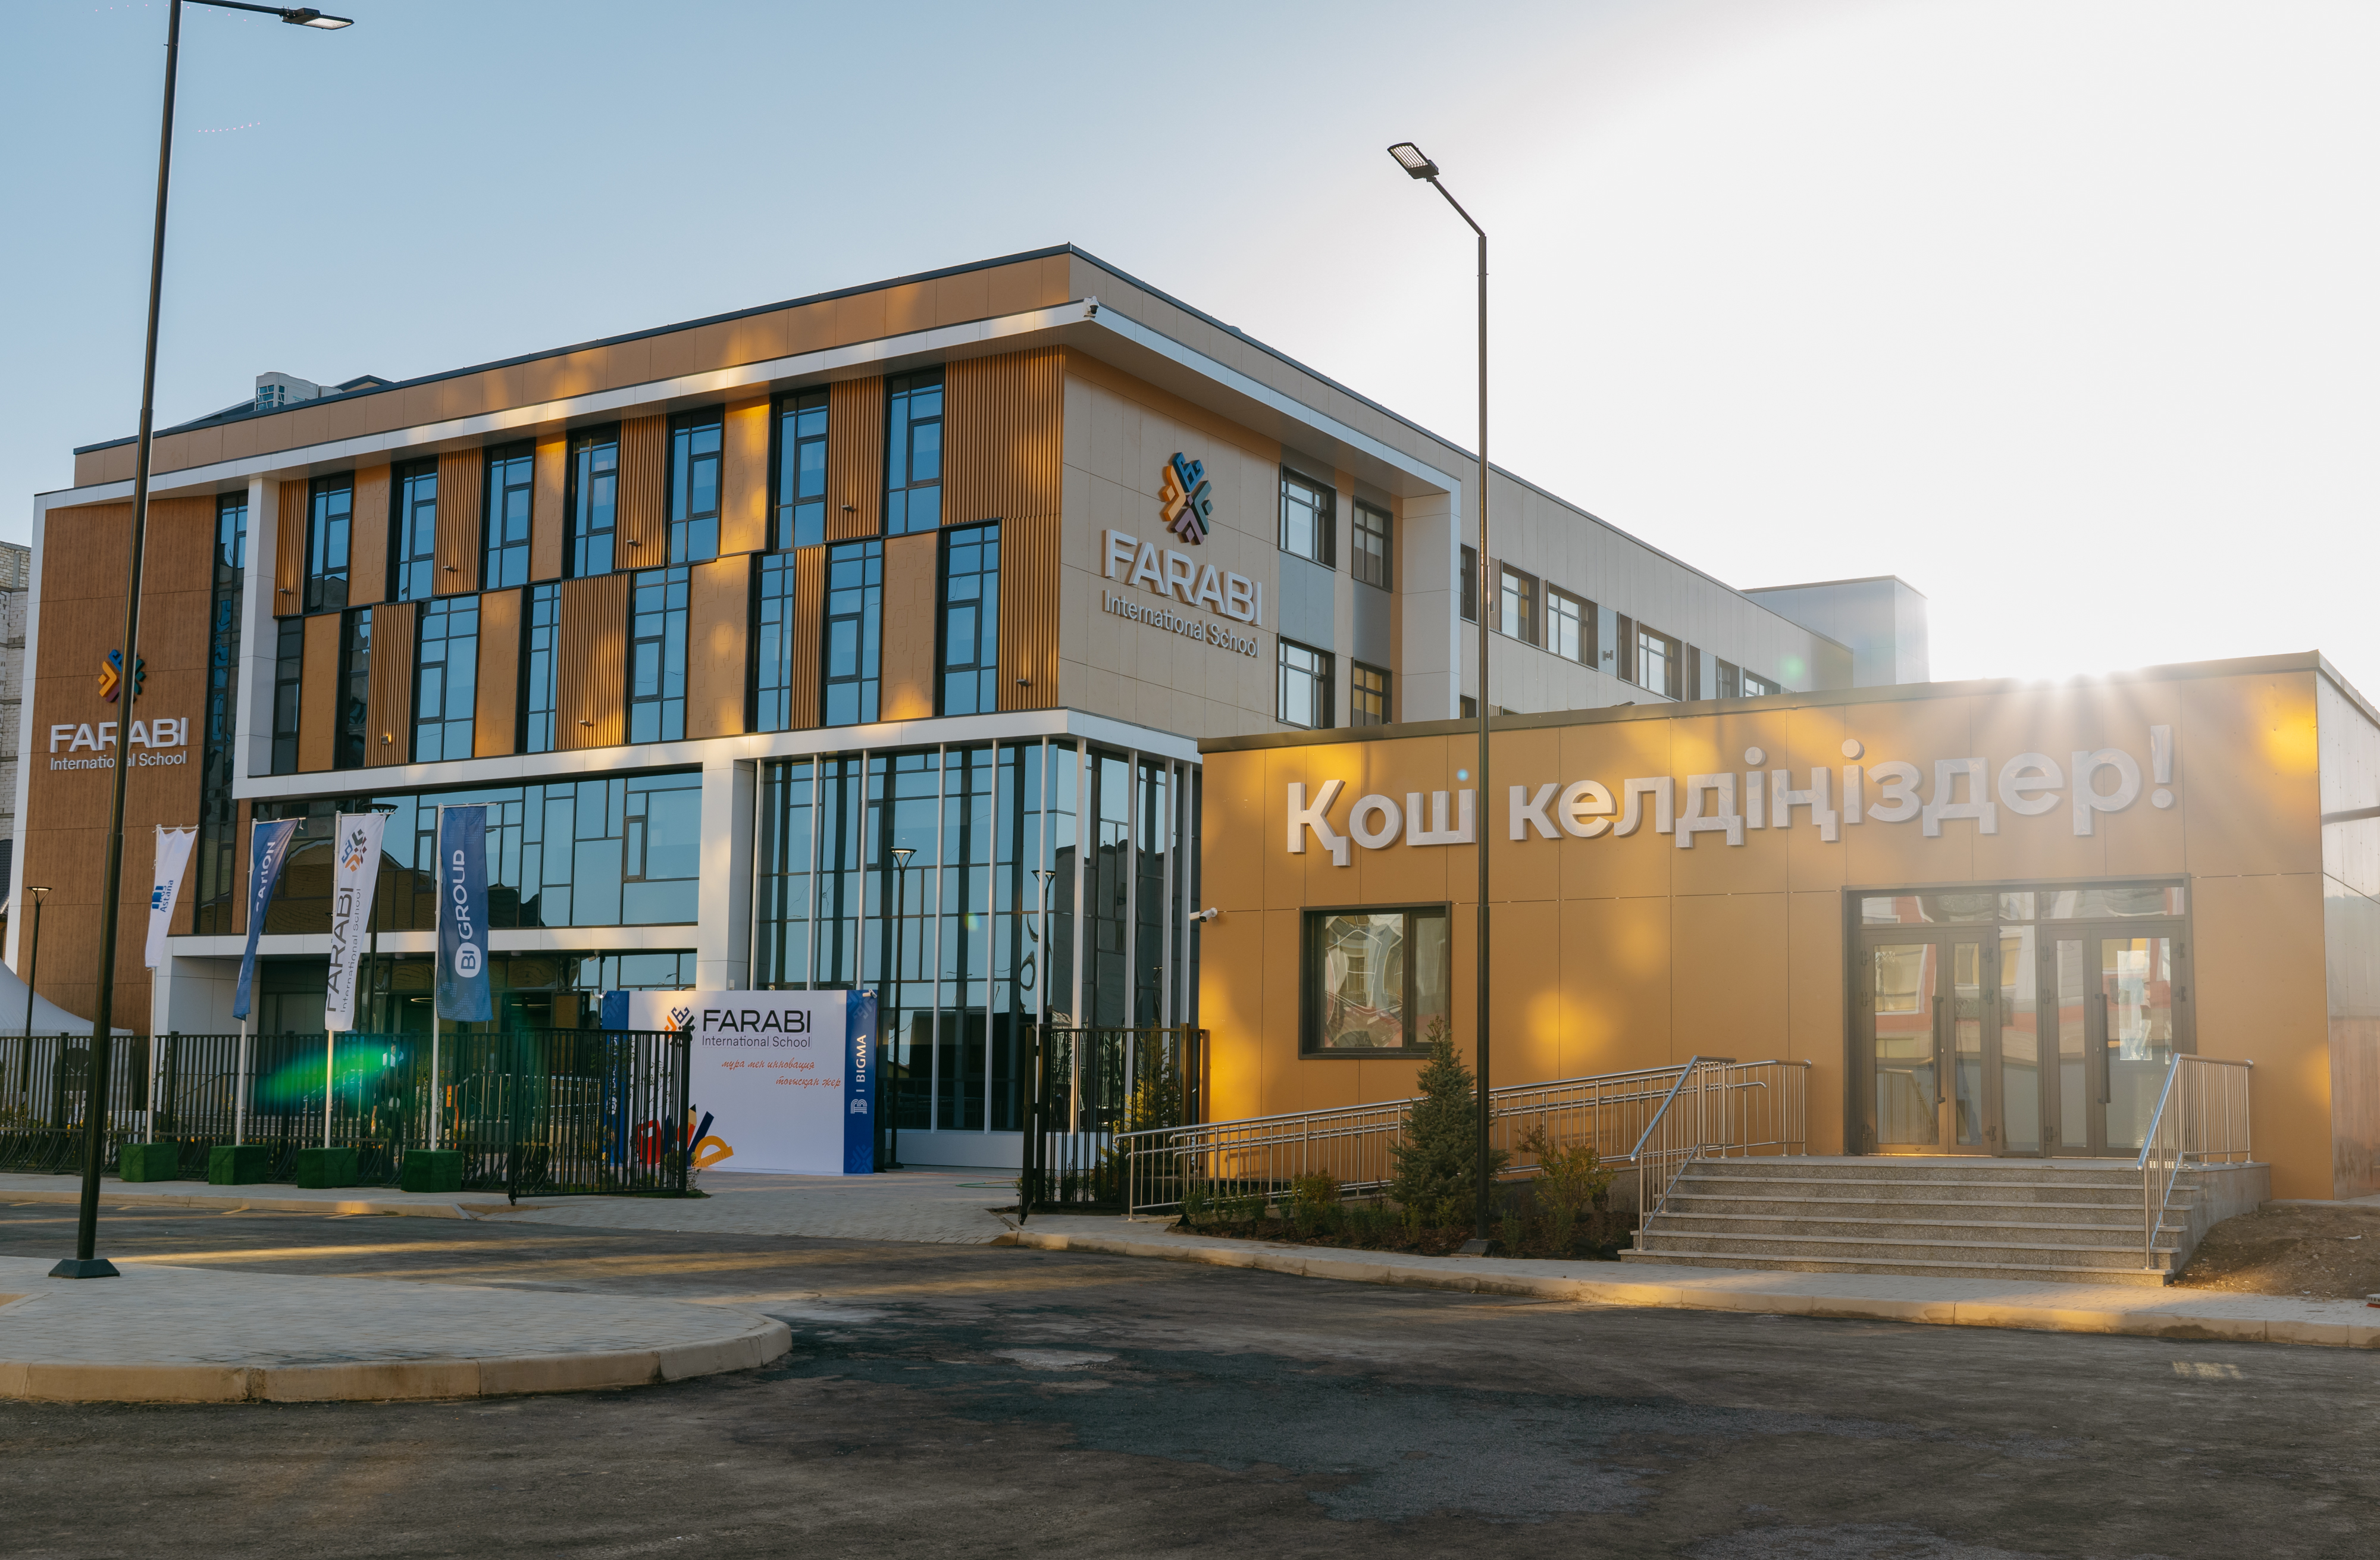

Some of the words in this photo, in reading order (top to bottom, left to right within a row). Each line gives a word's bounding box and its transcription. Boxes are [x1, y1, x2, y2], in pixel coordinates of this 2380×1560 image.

[1105, 529, 1261, 626] FARABI
[1104, 589, 1206, 641] International
[1210, 623, 1260, 657] School
[50, 717, 189, 753] FARABI
[51, 753, 137, 770] Internatioal
[139, 750, 187, 767] School
[1288, 779, 1477, 867] Қош
[1509, 724, 2175, 849] келдіңіздер!
[159, 880, 174, 913] Astana
[453, 850, 473, 940] GROUP
[340, 935, 358, 1013] International
[353, 889, 361, 931] School
[461, 950, 476, 970] BI
[703, 1009, 811, 1033] FARABI
[702, 1035, 769, 1047] International
[772, 1036, 810, 1048] School
[856, 1034, 867, 1082] BIGMA
[767, 1057, 815, 1072] инновация
